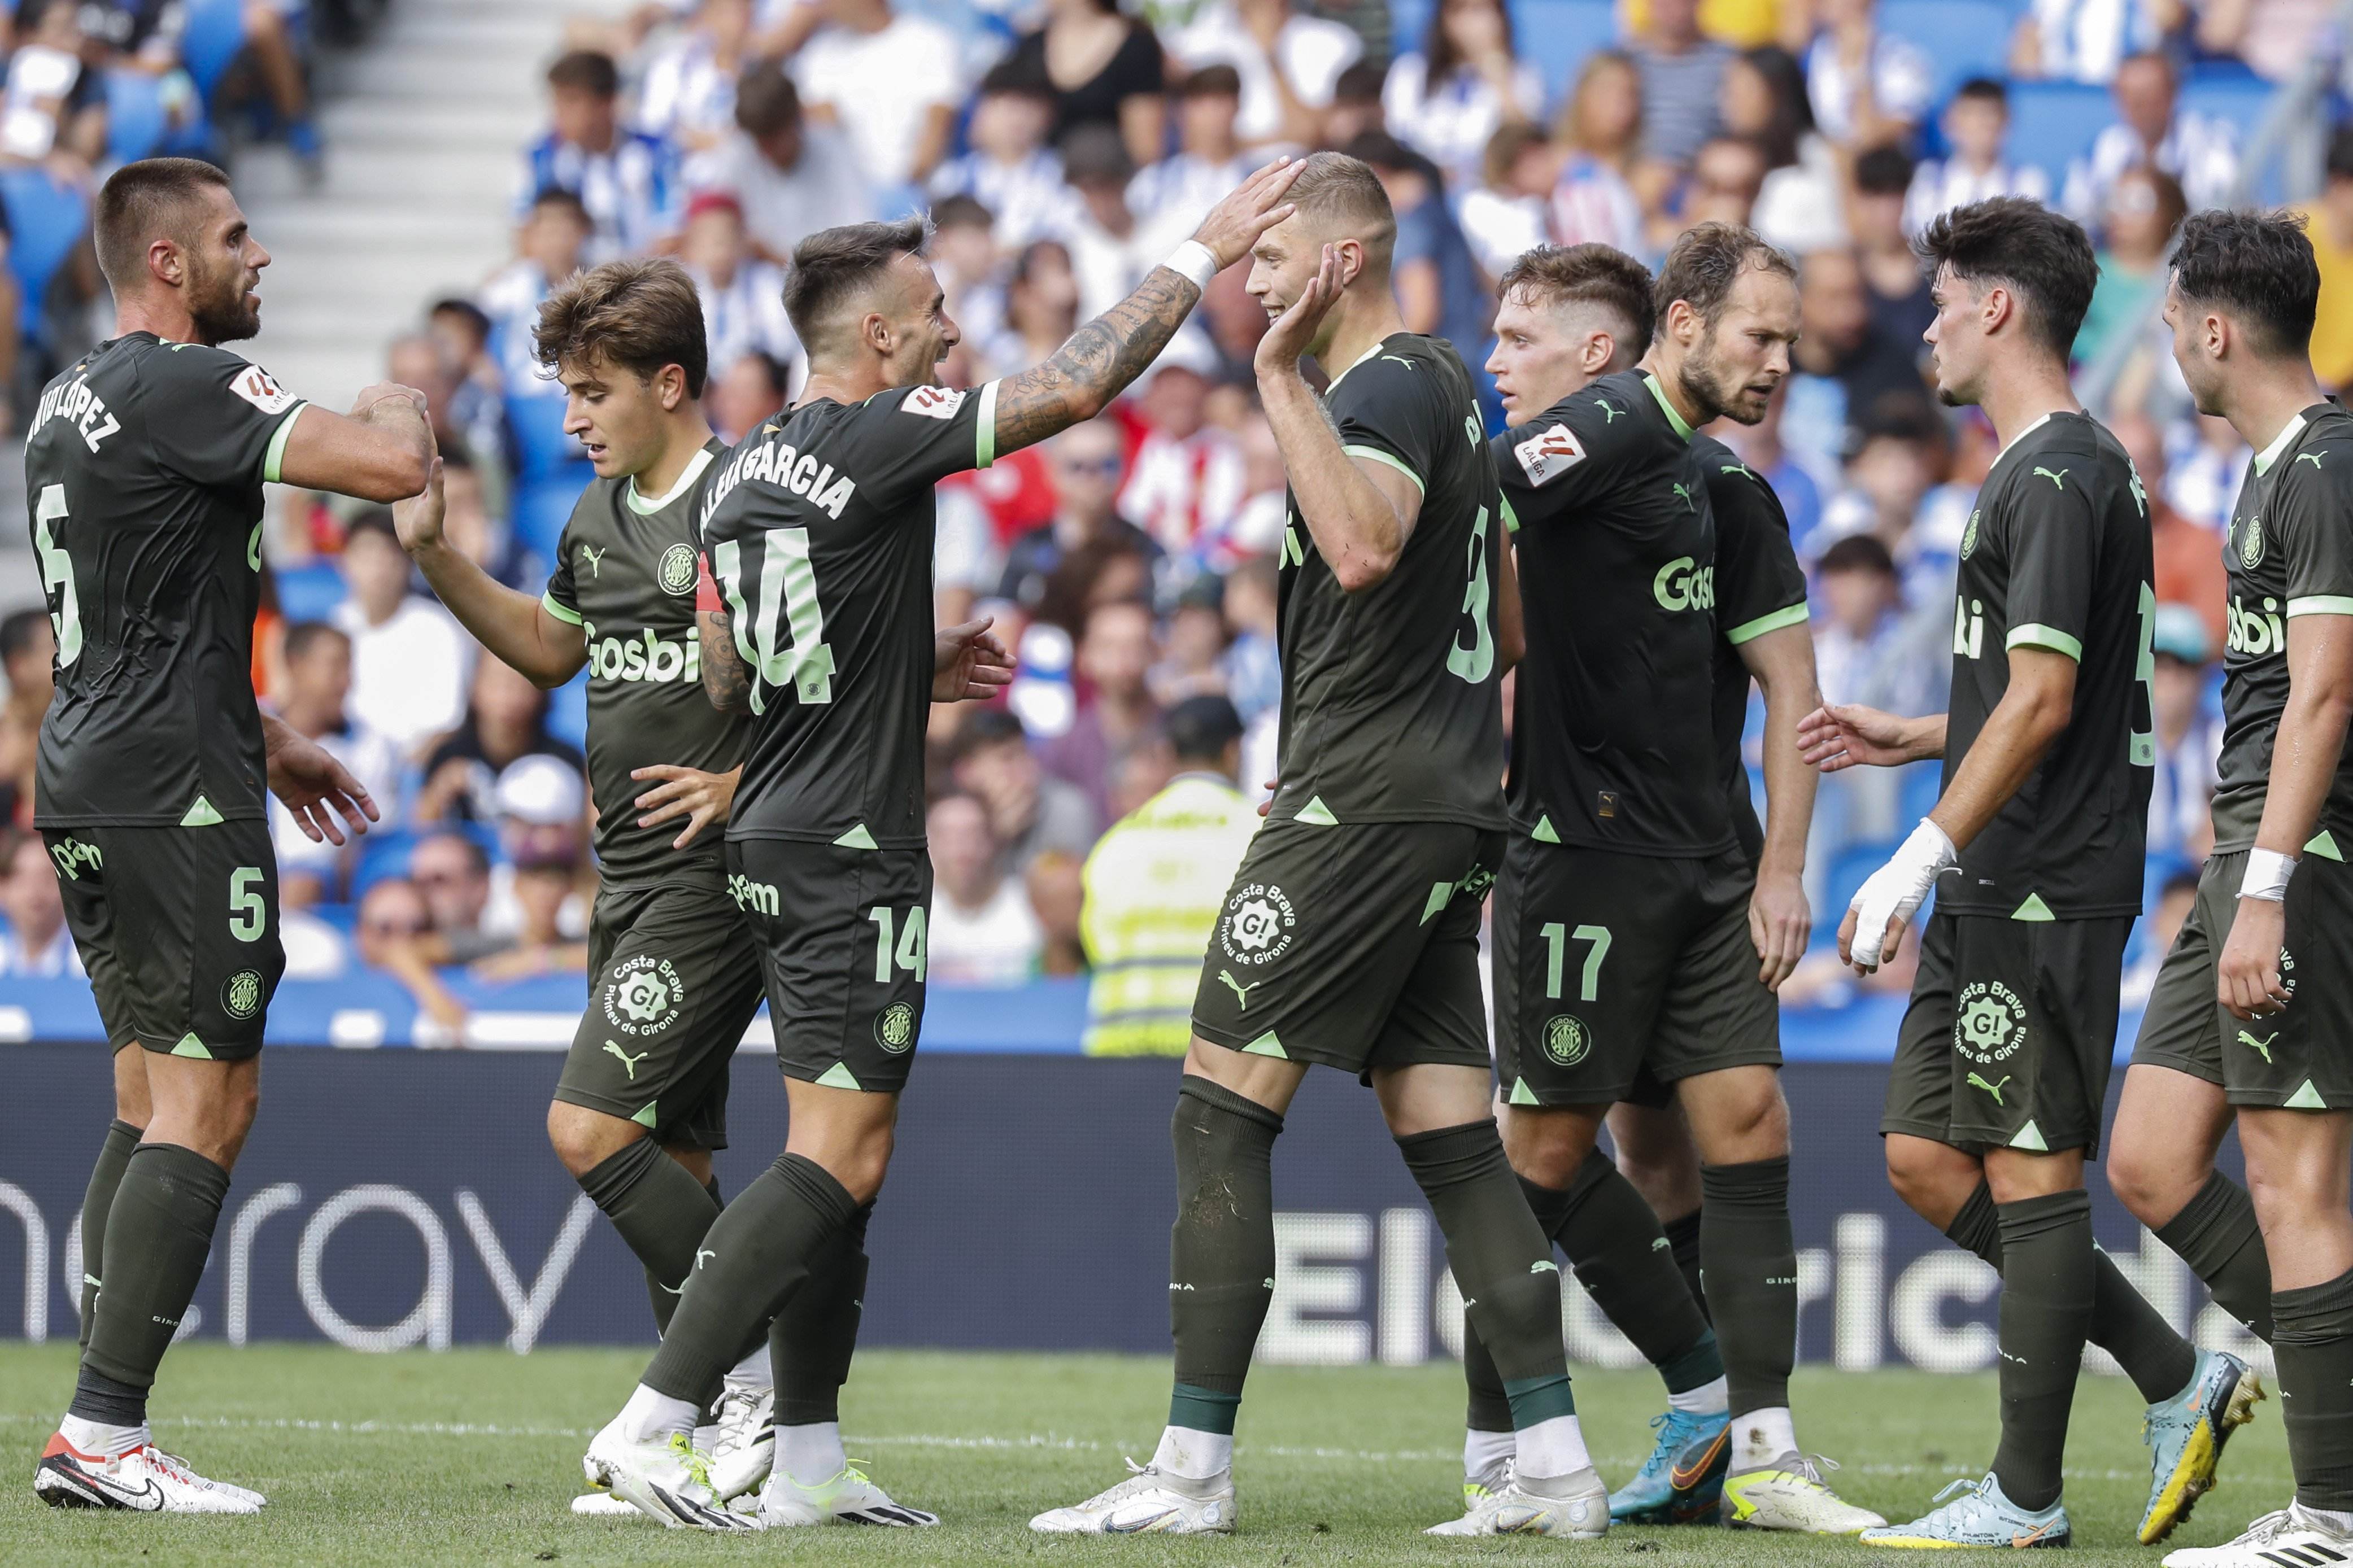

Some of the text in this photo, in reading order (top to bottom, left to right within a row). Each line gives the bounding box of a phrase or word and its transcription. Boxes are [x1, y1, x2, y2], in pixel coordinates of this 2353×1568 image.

[55, 373, 121, 453] LÓPEZ
[742, 441, 856, 520] GARCIA
[1523, 447, 1545, 477] LALIGA
[36, 483, 82, 669] 5
[668, 547, 694, 560] GIRONA
[716, 527, 836, 716] 14
[2227, 595, 2284, 654] osbi
[229, 867, 265, 942] 5
[1230, 883, 1296, 927] Costa Brava
[1243, 914, 1269, 940] G!
[868, 906, 927, 983] 14
[1221, 916, 1292, 965] Pirineu de Girona
[1540, 922, 1613, 1002] 17
[232, 972, 259, 984] GIRONA
[613, 954, 684, 1002] Costa Brava
[630, 985, 659, 1012] G!
[1990, 981, 2026, 1019] Brava
[604, 984, 679, 1036] Pirineu de Girona
[886, 1005, 912, 1017] GIRONA
[1550, 1017, 1580, 1029] GIRONA
[1973, 1013, 2000, 1037] G!
[1976, 1052, 1992, 1063] de
[1994, 1027, 2027, 1060] Girona
